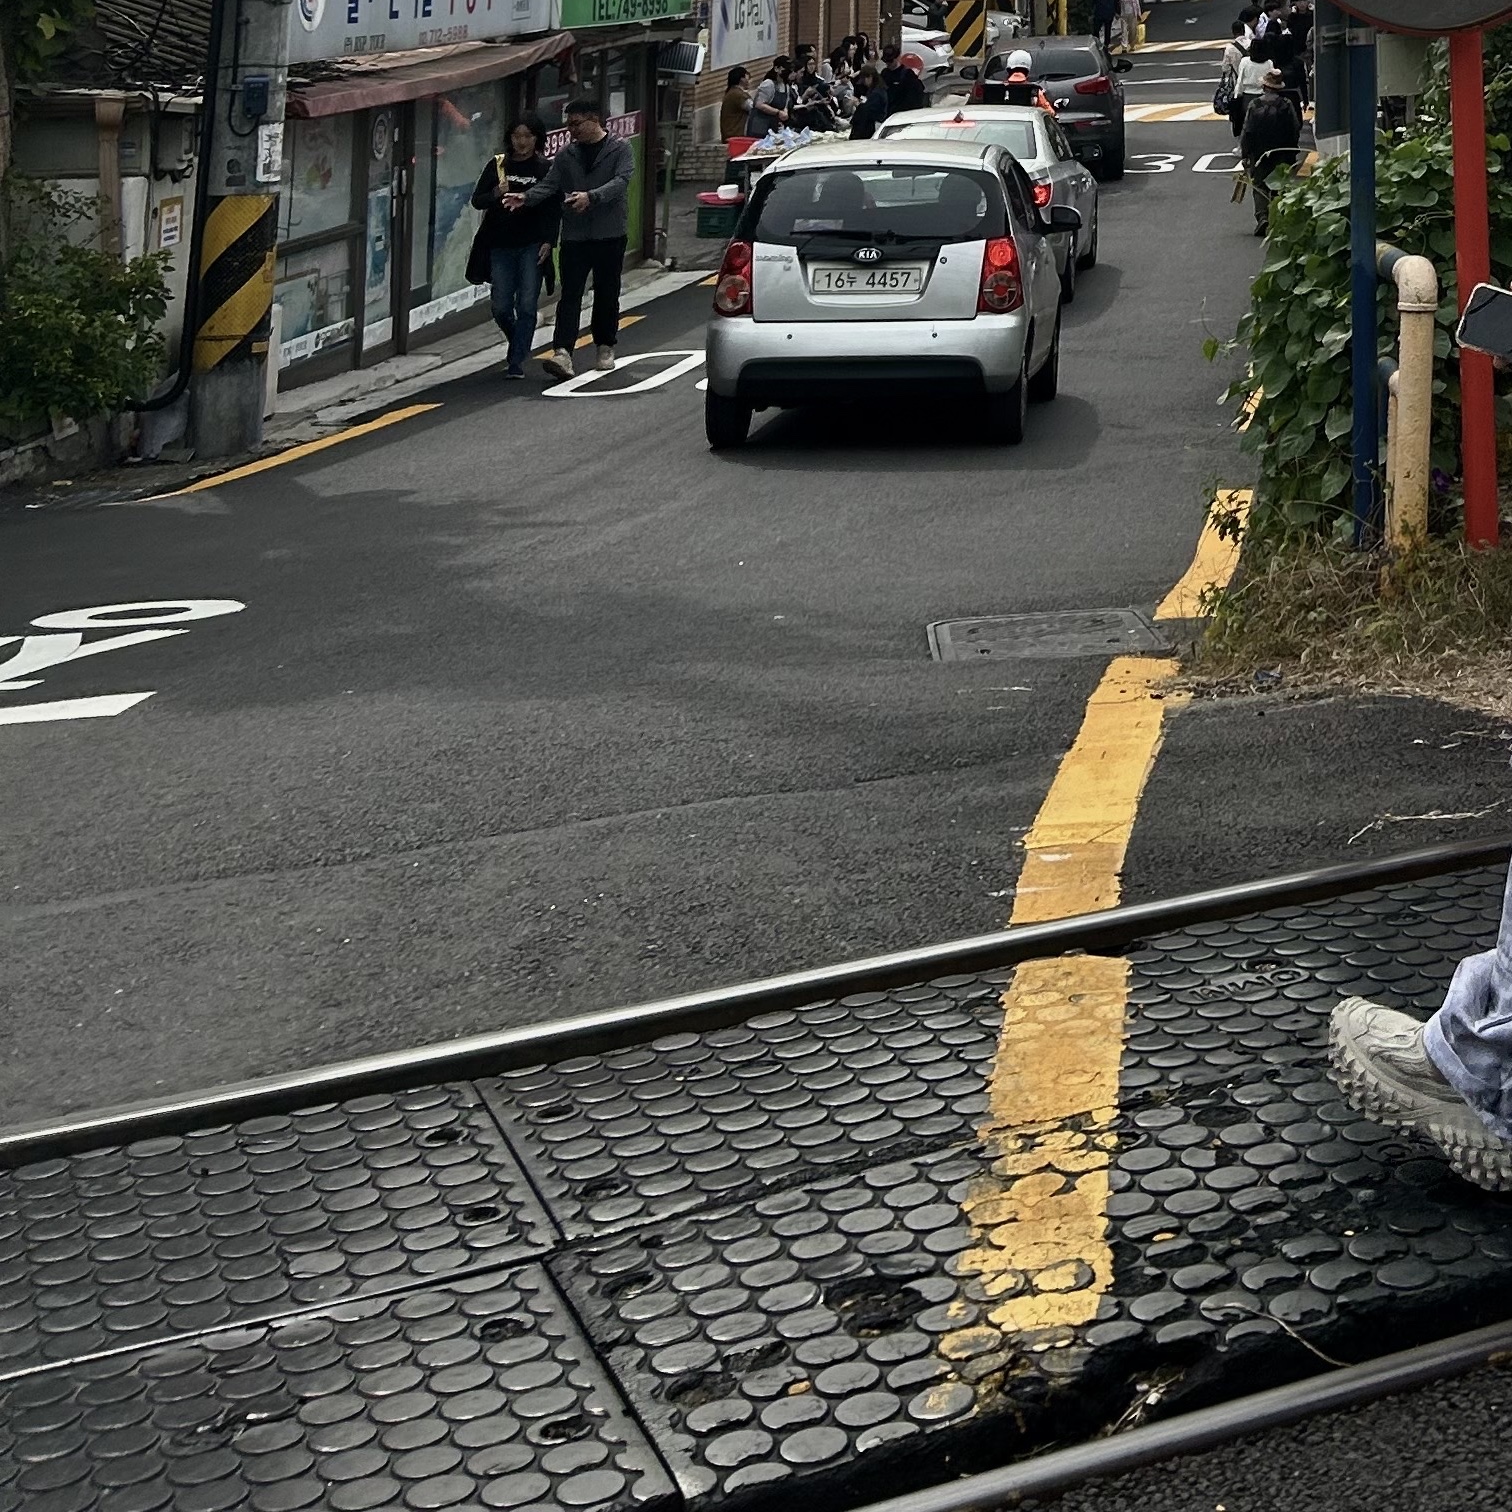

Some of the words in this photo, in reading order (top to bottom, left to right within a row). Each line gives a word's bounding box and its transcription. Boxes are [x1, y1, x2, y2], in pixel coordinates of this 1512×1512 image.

[858, 248, 878, 260] KIA
[824, 272, 857, 288] 16누
[865, 271, 911, 288] 4457
